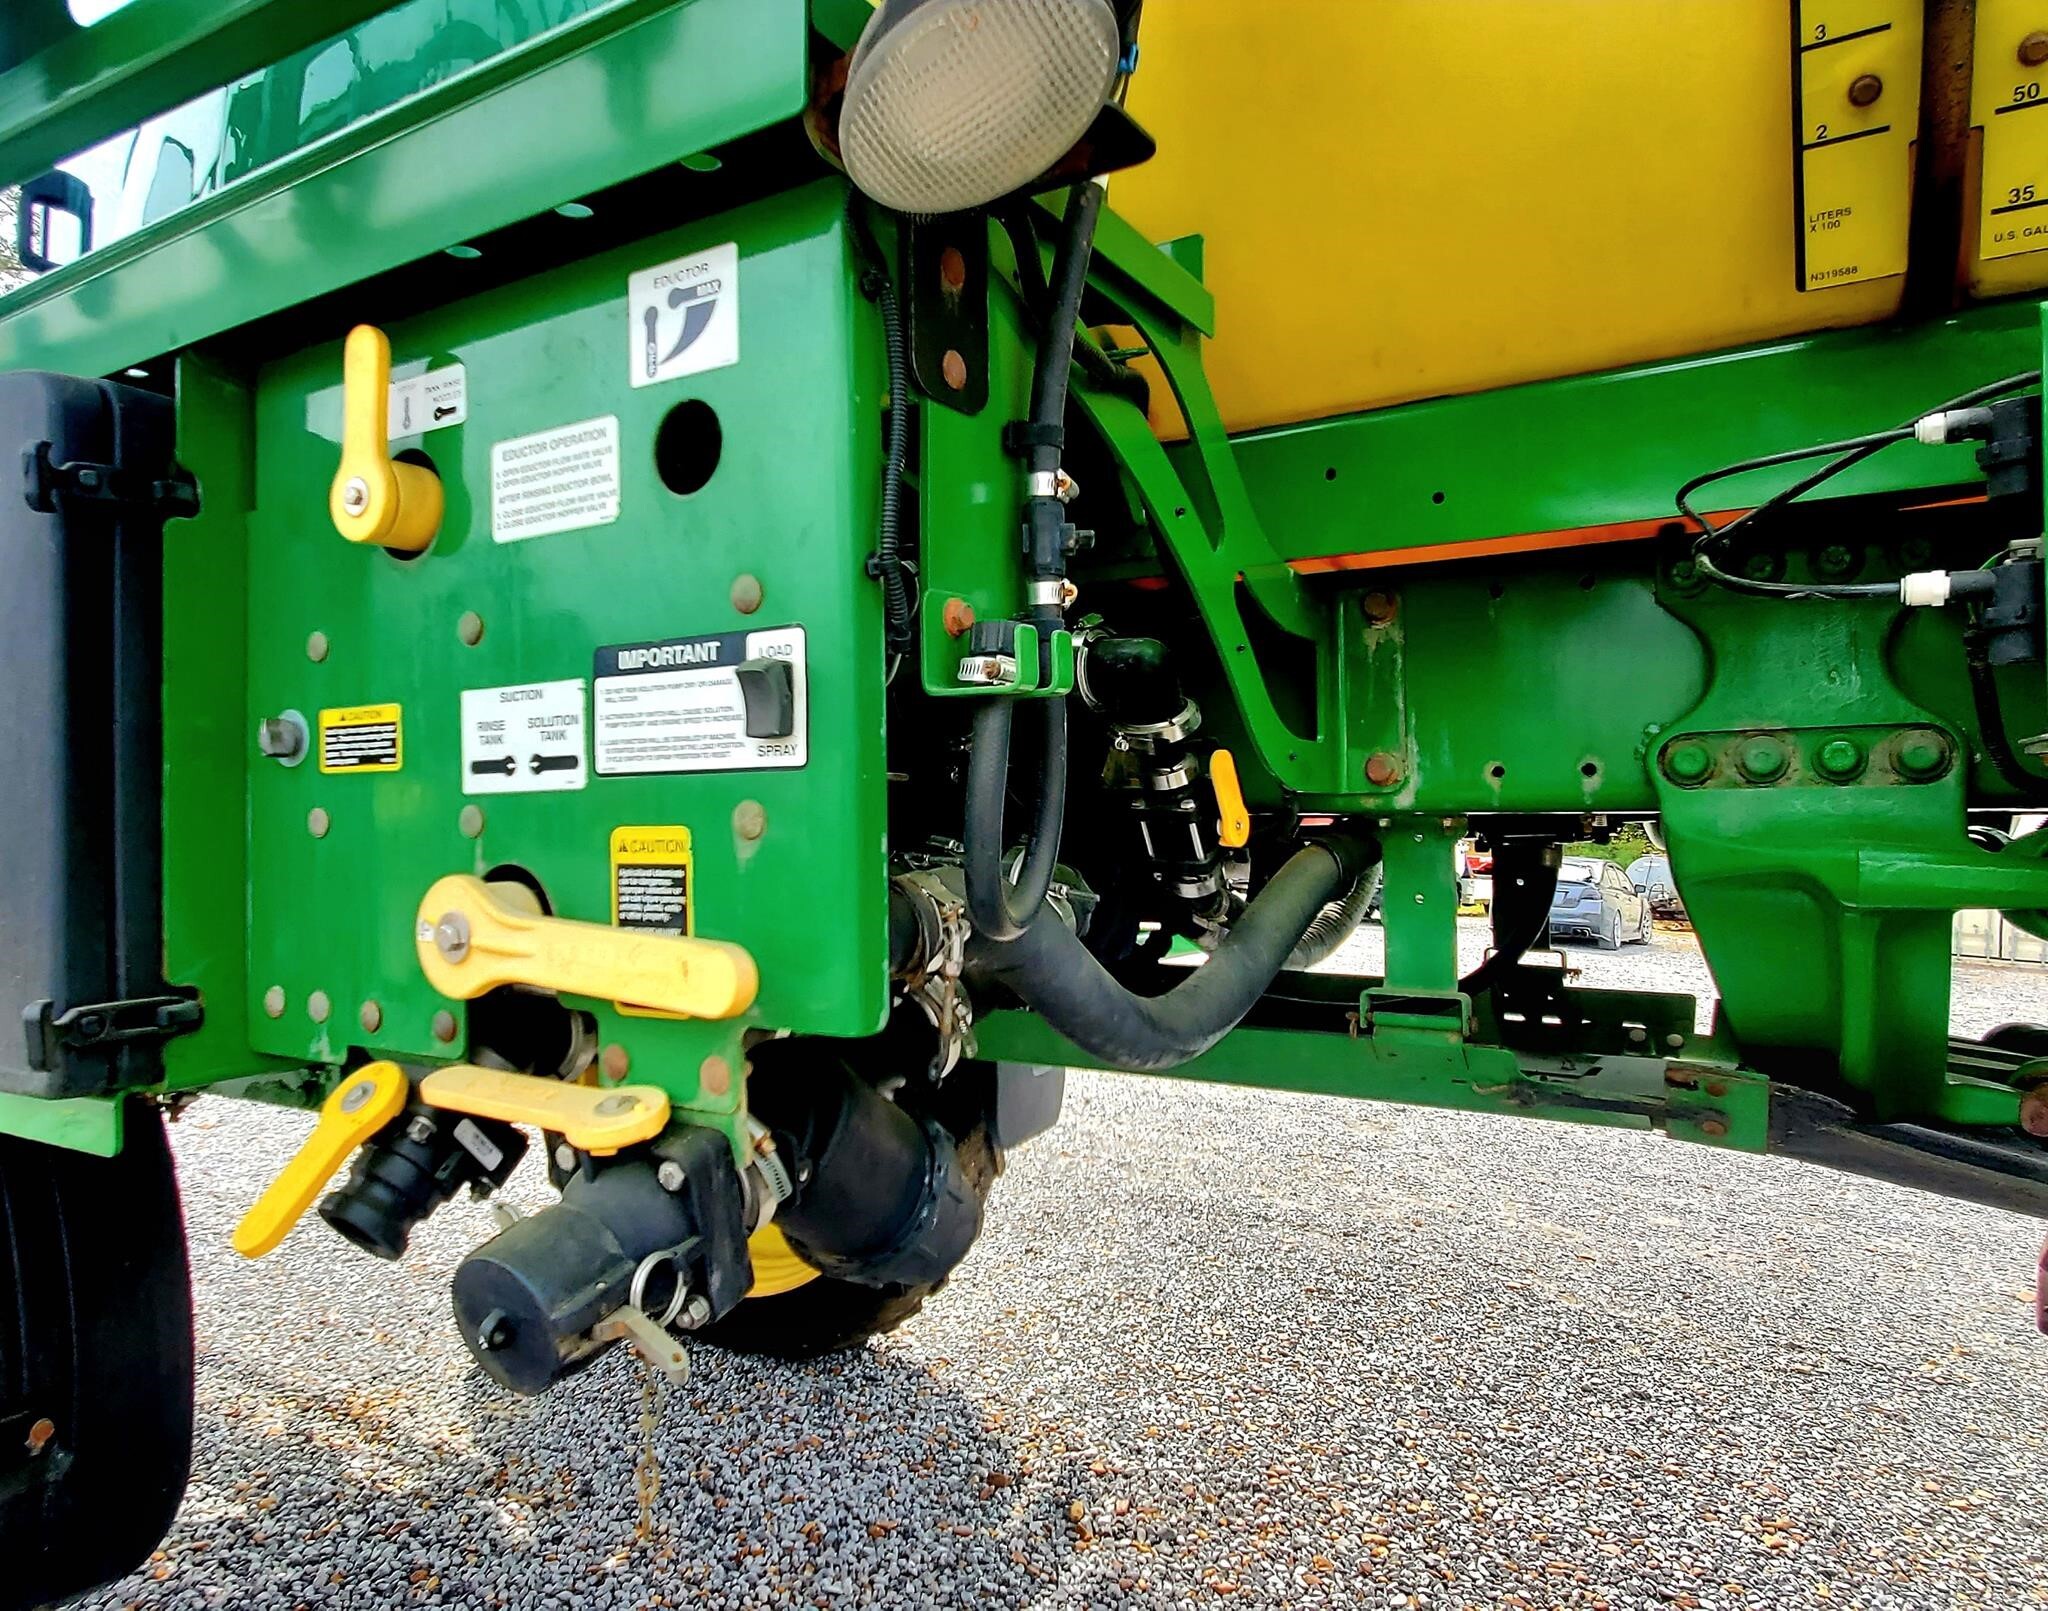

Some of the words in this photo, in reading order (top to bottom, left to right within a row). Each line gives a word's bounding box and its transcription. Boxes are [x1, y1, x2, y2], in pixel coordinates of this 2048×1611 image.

[1815, 24, 1826, 40] 3
[2013, 82, 2040, 102] 50
[1816, 125, 1827, 140] 2
[2008, 185, 2035, 204] 35
[1809, 207, 1852, 223] LITERS
[1810, 224, 1817, 233] X
[1822, 220, 1841, 231] 100
[654, 262, 709, 289] EDUCTOR
[1810, 266, 1858, 282] N319588
[502, 442, 548, 462] EDUCTOR
[549, 427, 607, 450] OPERATION
[618, 641, 721, 670] IMPORTANT
[758, 644, 793, 659] LOAD
[499, 689, 544, 703] SUCTION
[477, 720, 506, 732] RINSE
[527, 714, 579, 729] SOLUTION
[479, 734, 504, 745] TANK
[540, 730, 567, 742] TANK
[757, 744, 798, 758] SPRAY
[631, 840, 684, 853] CAUTION
